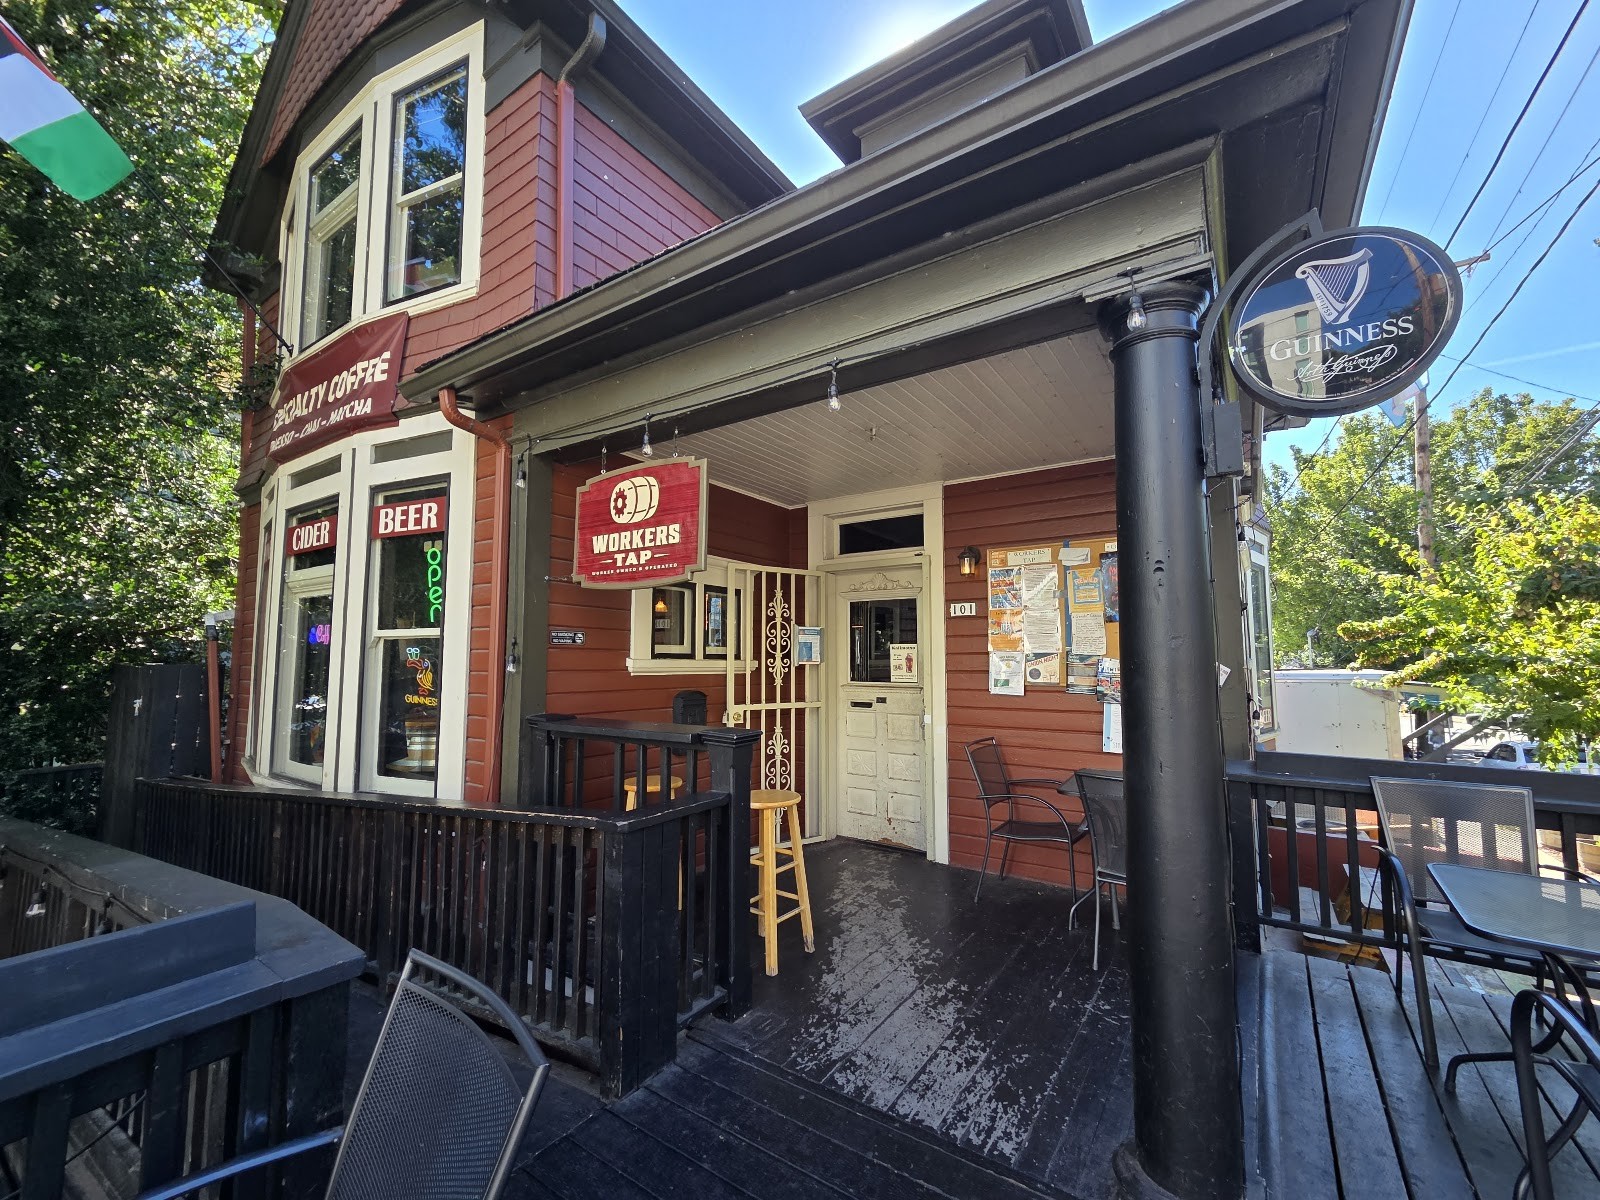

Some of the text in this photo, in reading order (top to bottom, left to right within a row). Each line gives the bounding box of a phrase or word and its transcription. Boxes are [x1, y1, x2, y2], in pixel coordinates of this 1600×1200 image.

[1270, 315, 1414, 361] GUINNESS
[327, 350, 391, 403] COFFEE
[326, 397, 372, 427] MATCHA
[378, 502, 438, 535] BEER
[292, 520, 330, 551] CIDER
[592, 523, 680, 554] WORKERS
[614, 550, 652, 567] TAP
[644, 562, 678, 570] OPERATED
[952, 603, 974, 615] 101
